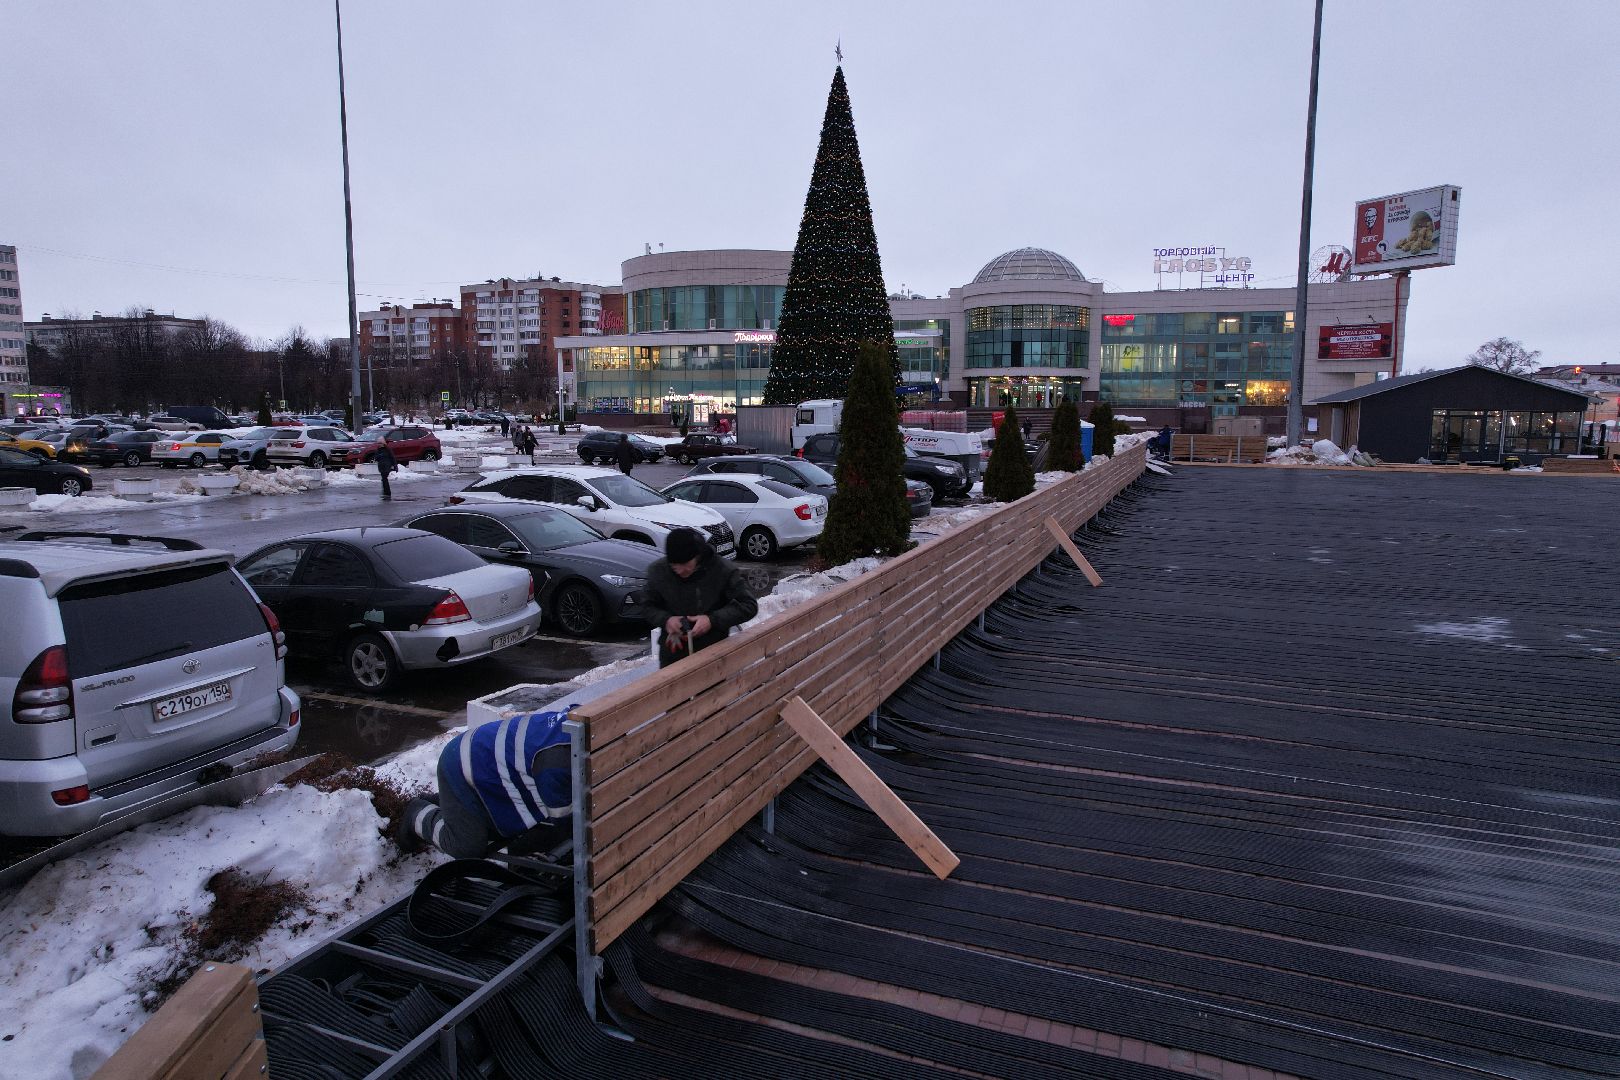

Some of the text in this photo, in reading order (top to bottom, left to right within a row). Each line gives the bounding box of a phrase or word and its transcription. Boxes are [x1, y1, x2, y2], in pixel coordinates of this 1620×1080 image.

[1361, 235, 1379, 243] KFC
[1153, 245, 1216, 257] ТОРГОВЫЙ
[1153, 256, 1252, 274] ГЛОБУС
[1215, 273, 1255, 283] ЦЕНТР
[210, 684, 229, 698] 150
